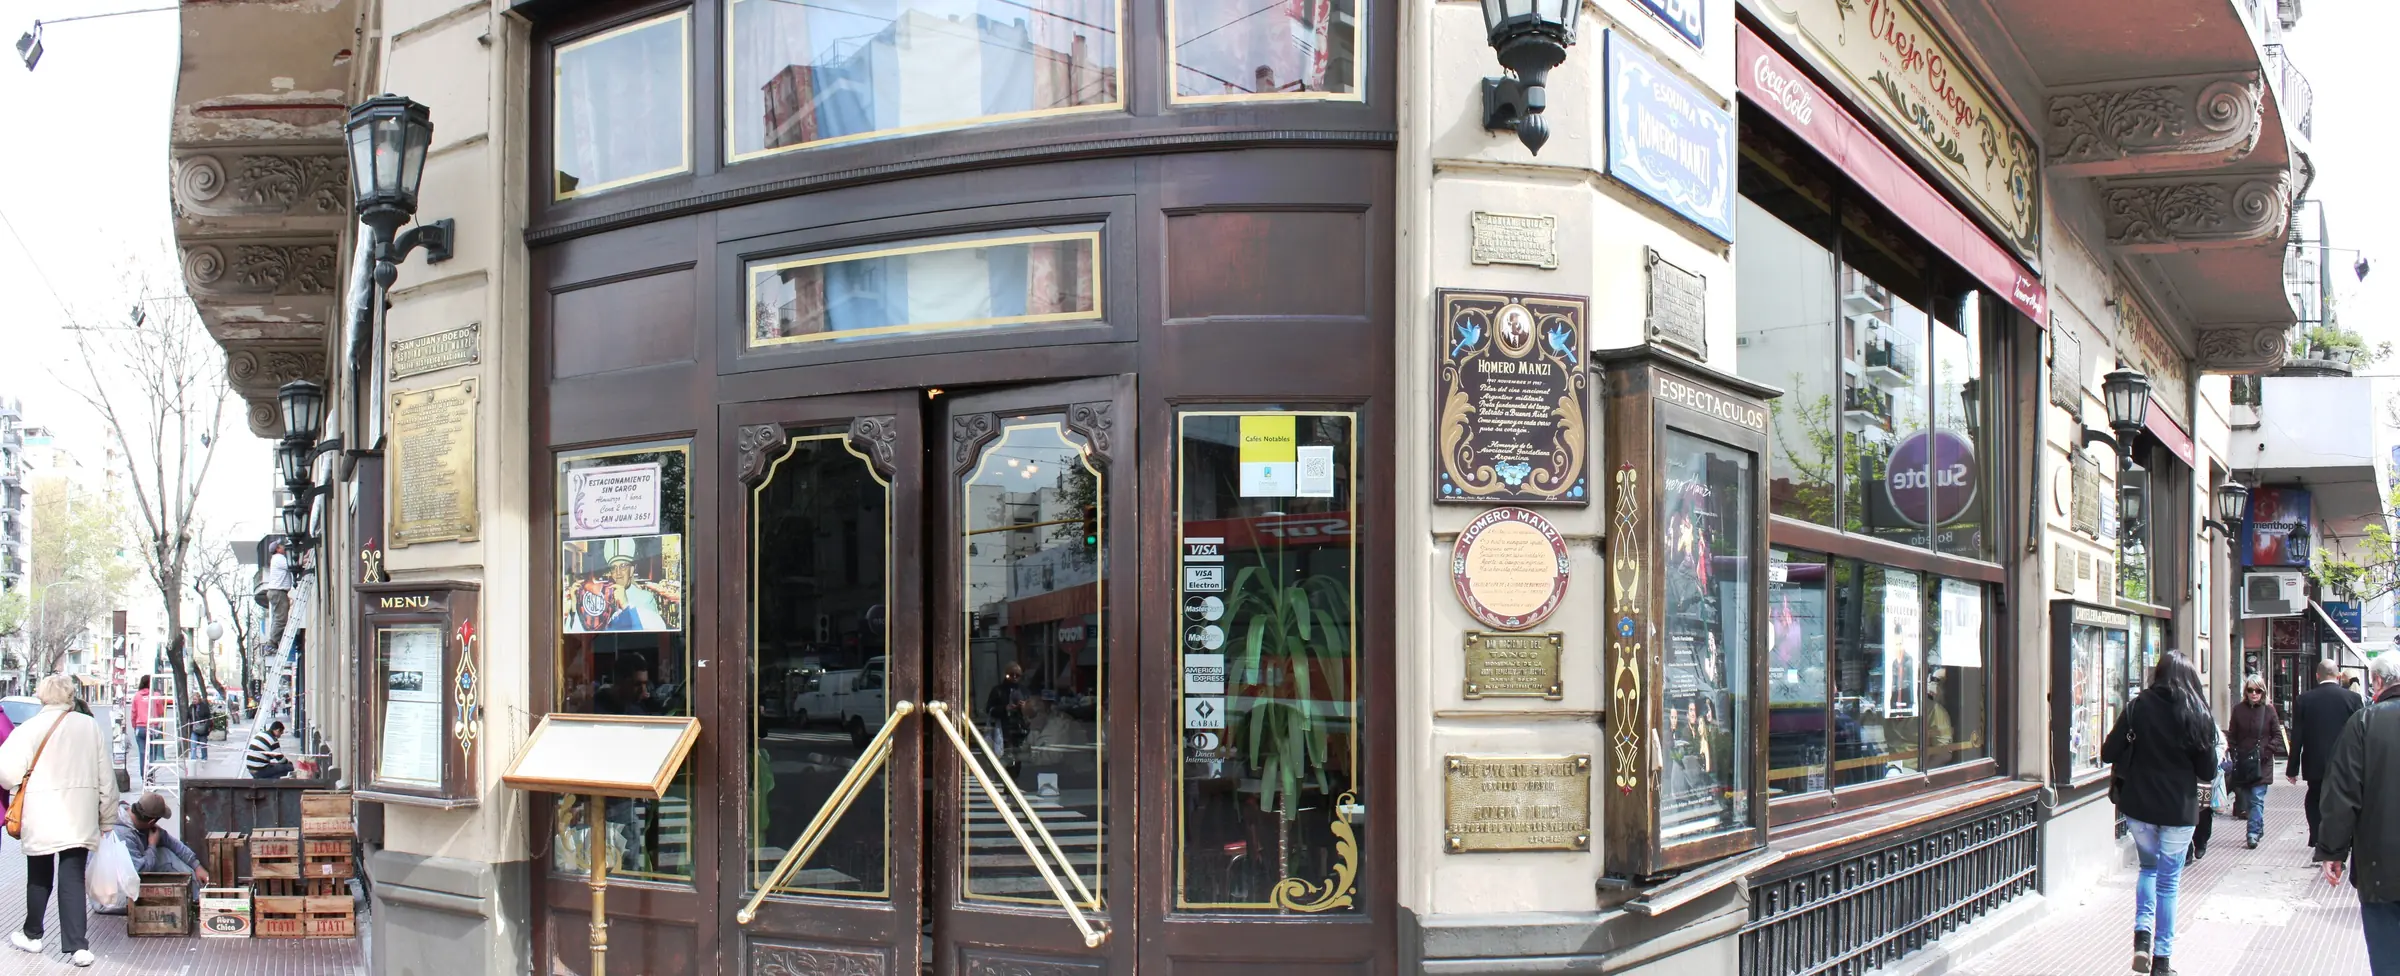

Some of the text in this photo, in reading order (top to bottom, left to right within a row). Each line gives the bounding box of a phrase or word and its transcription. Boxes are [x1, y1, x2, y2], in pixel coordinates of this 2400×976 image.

[1865, 0, 1925, 75] Viejo
[1926, 47, 1975, 129] Ciego
[1754, 54, 1812, 126] Coca-Cola
[1653, 82, 1696, 128] ESQUINA
[1638, 101, 1710, 190] HOMERO MANZI
[399, 340, 414, 351] SAN
[415, 335, 436, 348] JUAN
[442, 329, 470, 342] BOEDO
[1478, 359, 1551, 376] HOMERO MANZI
[1480, 384, 1497, 392] Pilar
[1480, 392, 1544, 402] Argentino militante
[1479, 399, 1495, 408] Poeta
[1495, 401, 1528, 411] fundamental
[1536, 403, 1551, 413] tango
[1659, 377, 1764, 429] ESPECTACULOS
[1479, 408, 1504, 416] Retrató
[1509, 408, 1531, 418] Buenos
[1531, 410, 1549, 419] Aires
[1477, 416, 1491, 424] Como
[1491, 416, 1512, 427] ninguno
[1479, 426, 1494, 434] puso
[1487, 440, 1519, 452] Homenaje
[589, 475, 651, 487] ESTACIONAMIENTO
[602, 484, 638, 494] SIN CARGO
[595, 496, 621, 504] Almuerzo
[629, 493, 642, 501] hora
[599, 503, 638, 514] Cena 2 horas
[600, 515, 614, 523] SAN
[614, 514, 632, 522] JUAN
[634, 512, 651, 520] 3651
[1462, 510, 1559, 544] HOMERO MANZI
[2253, 521, 2307, 532] menthops
[1191, 544, 1217, 555] VISA
[381, 595, 430, 608] MENU
[1489, 651, 1538, 659] TANGO
[1190, 719, 1219, 727] CABAL
[217, 916, 235, 924] Abra
[216, 923, 236, 931] Chica
[267, 921, 295, 932] ITATI
[316, 920, 345, 932] ITATI
